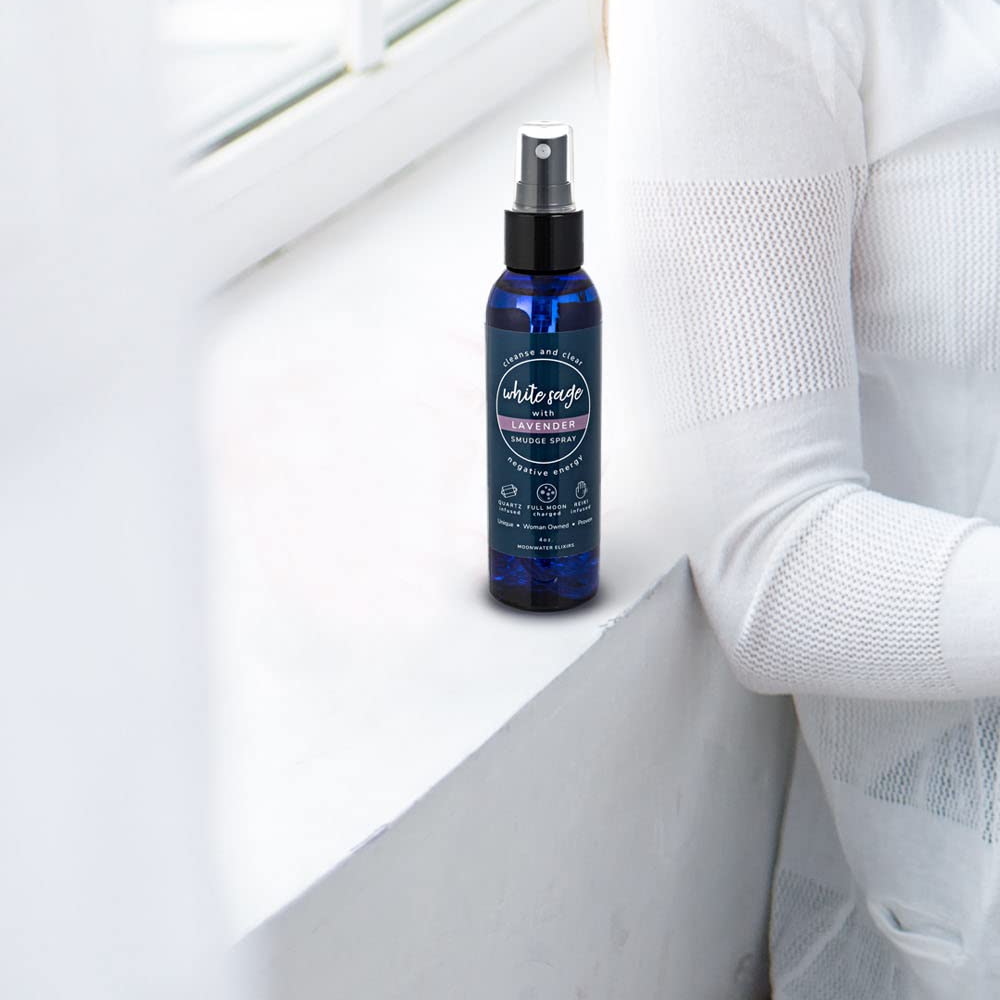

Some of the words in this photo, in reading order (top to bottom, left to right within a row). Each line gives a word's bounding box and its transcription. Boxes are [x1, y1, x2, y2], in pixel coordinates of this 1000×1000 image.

[502, 349, 535, 368] cleanse
[562, 352, 583, 366] clear
[503, 380, 546, 405] white
[547, 384, 583, 409] sage
[511, 420, 576, 431] LAVENDER
[510, 436, 547, 445] SMUDGE
[549, 435, 577, 444] SPRAY
[507, 456, 549, 477] negative
[553, 454, 583, 476] energy
